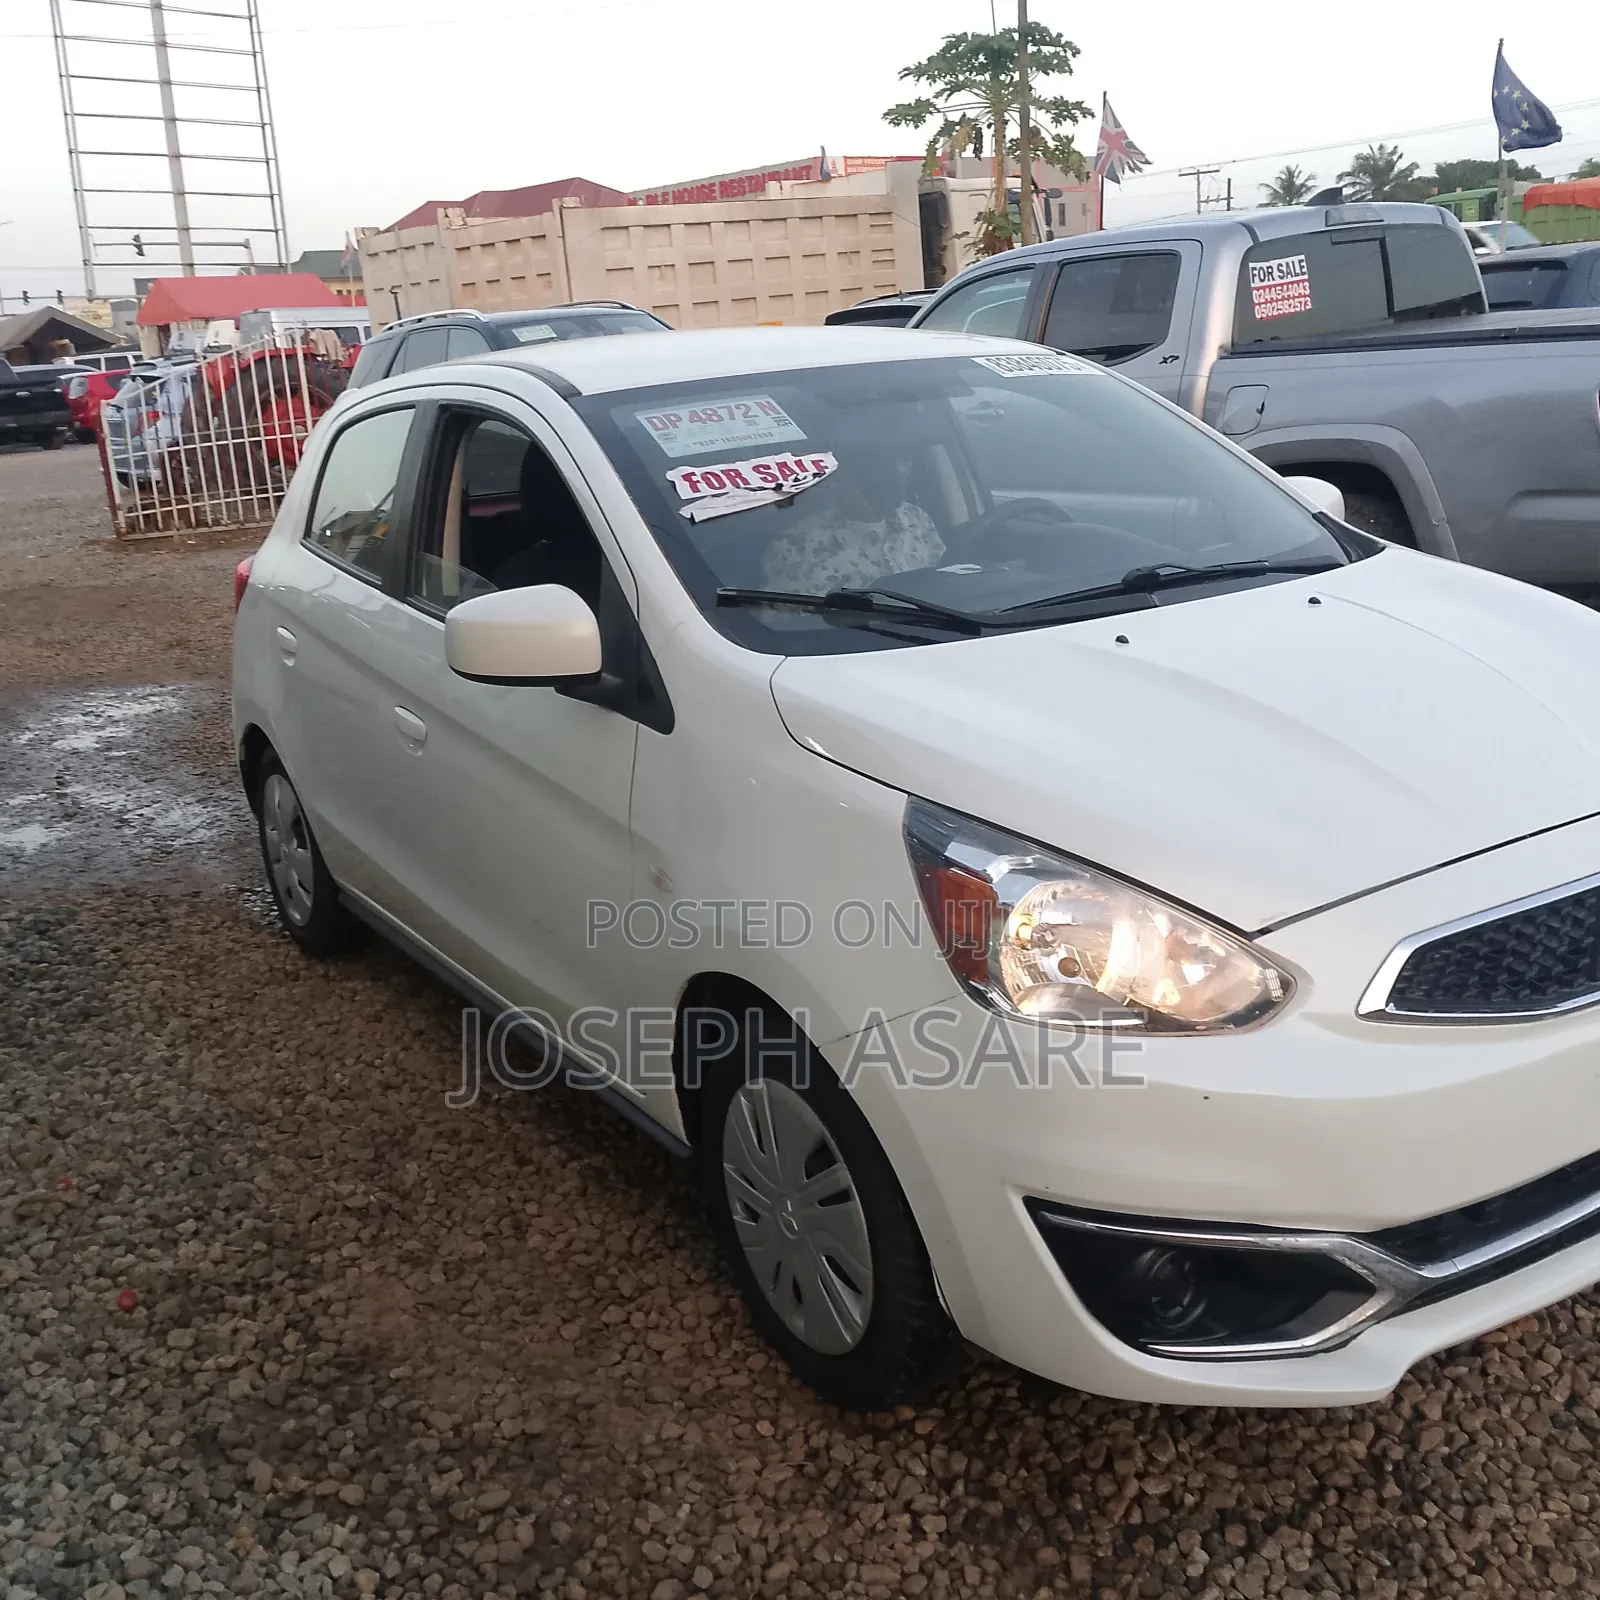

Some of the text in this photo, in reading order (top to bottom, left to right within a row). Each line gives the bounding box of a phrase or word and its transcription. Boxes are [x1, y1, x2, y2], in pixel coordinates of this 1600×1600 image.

[672, 182, 716, 204] HOUSE
[1251, 259, 1307, 284] FOR SALE
[1254, 297, 1312, 319] 0502582573
[645, 413, 682, 432] DP
[688, 404, 759, 425] 4872
[754, 400, 782, 416] N
[681, 468, 751, 494] FOR
